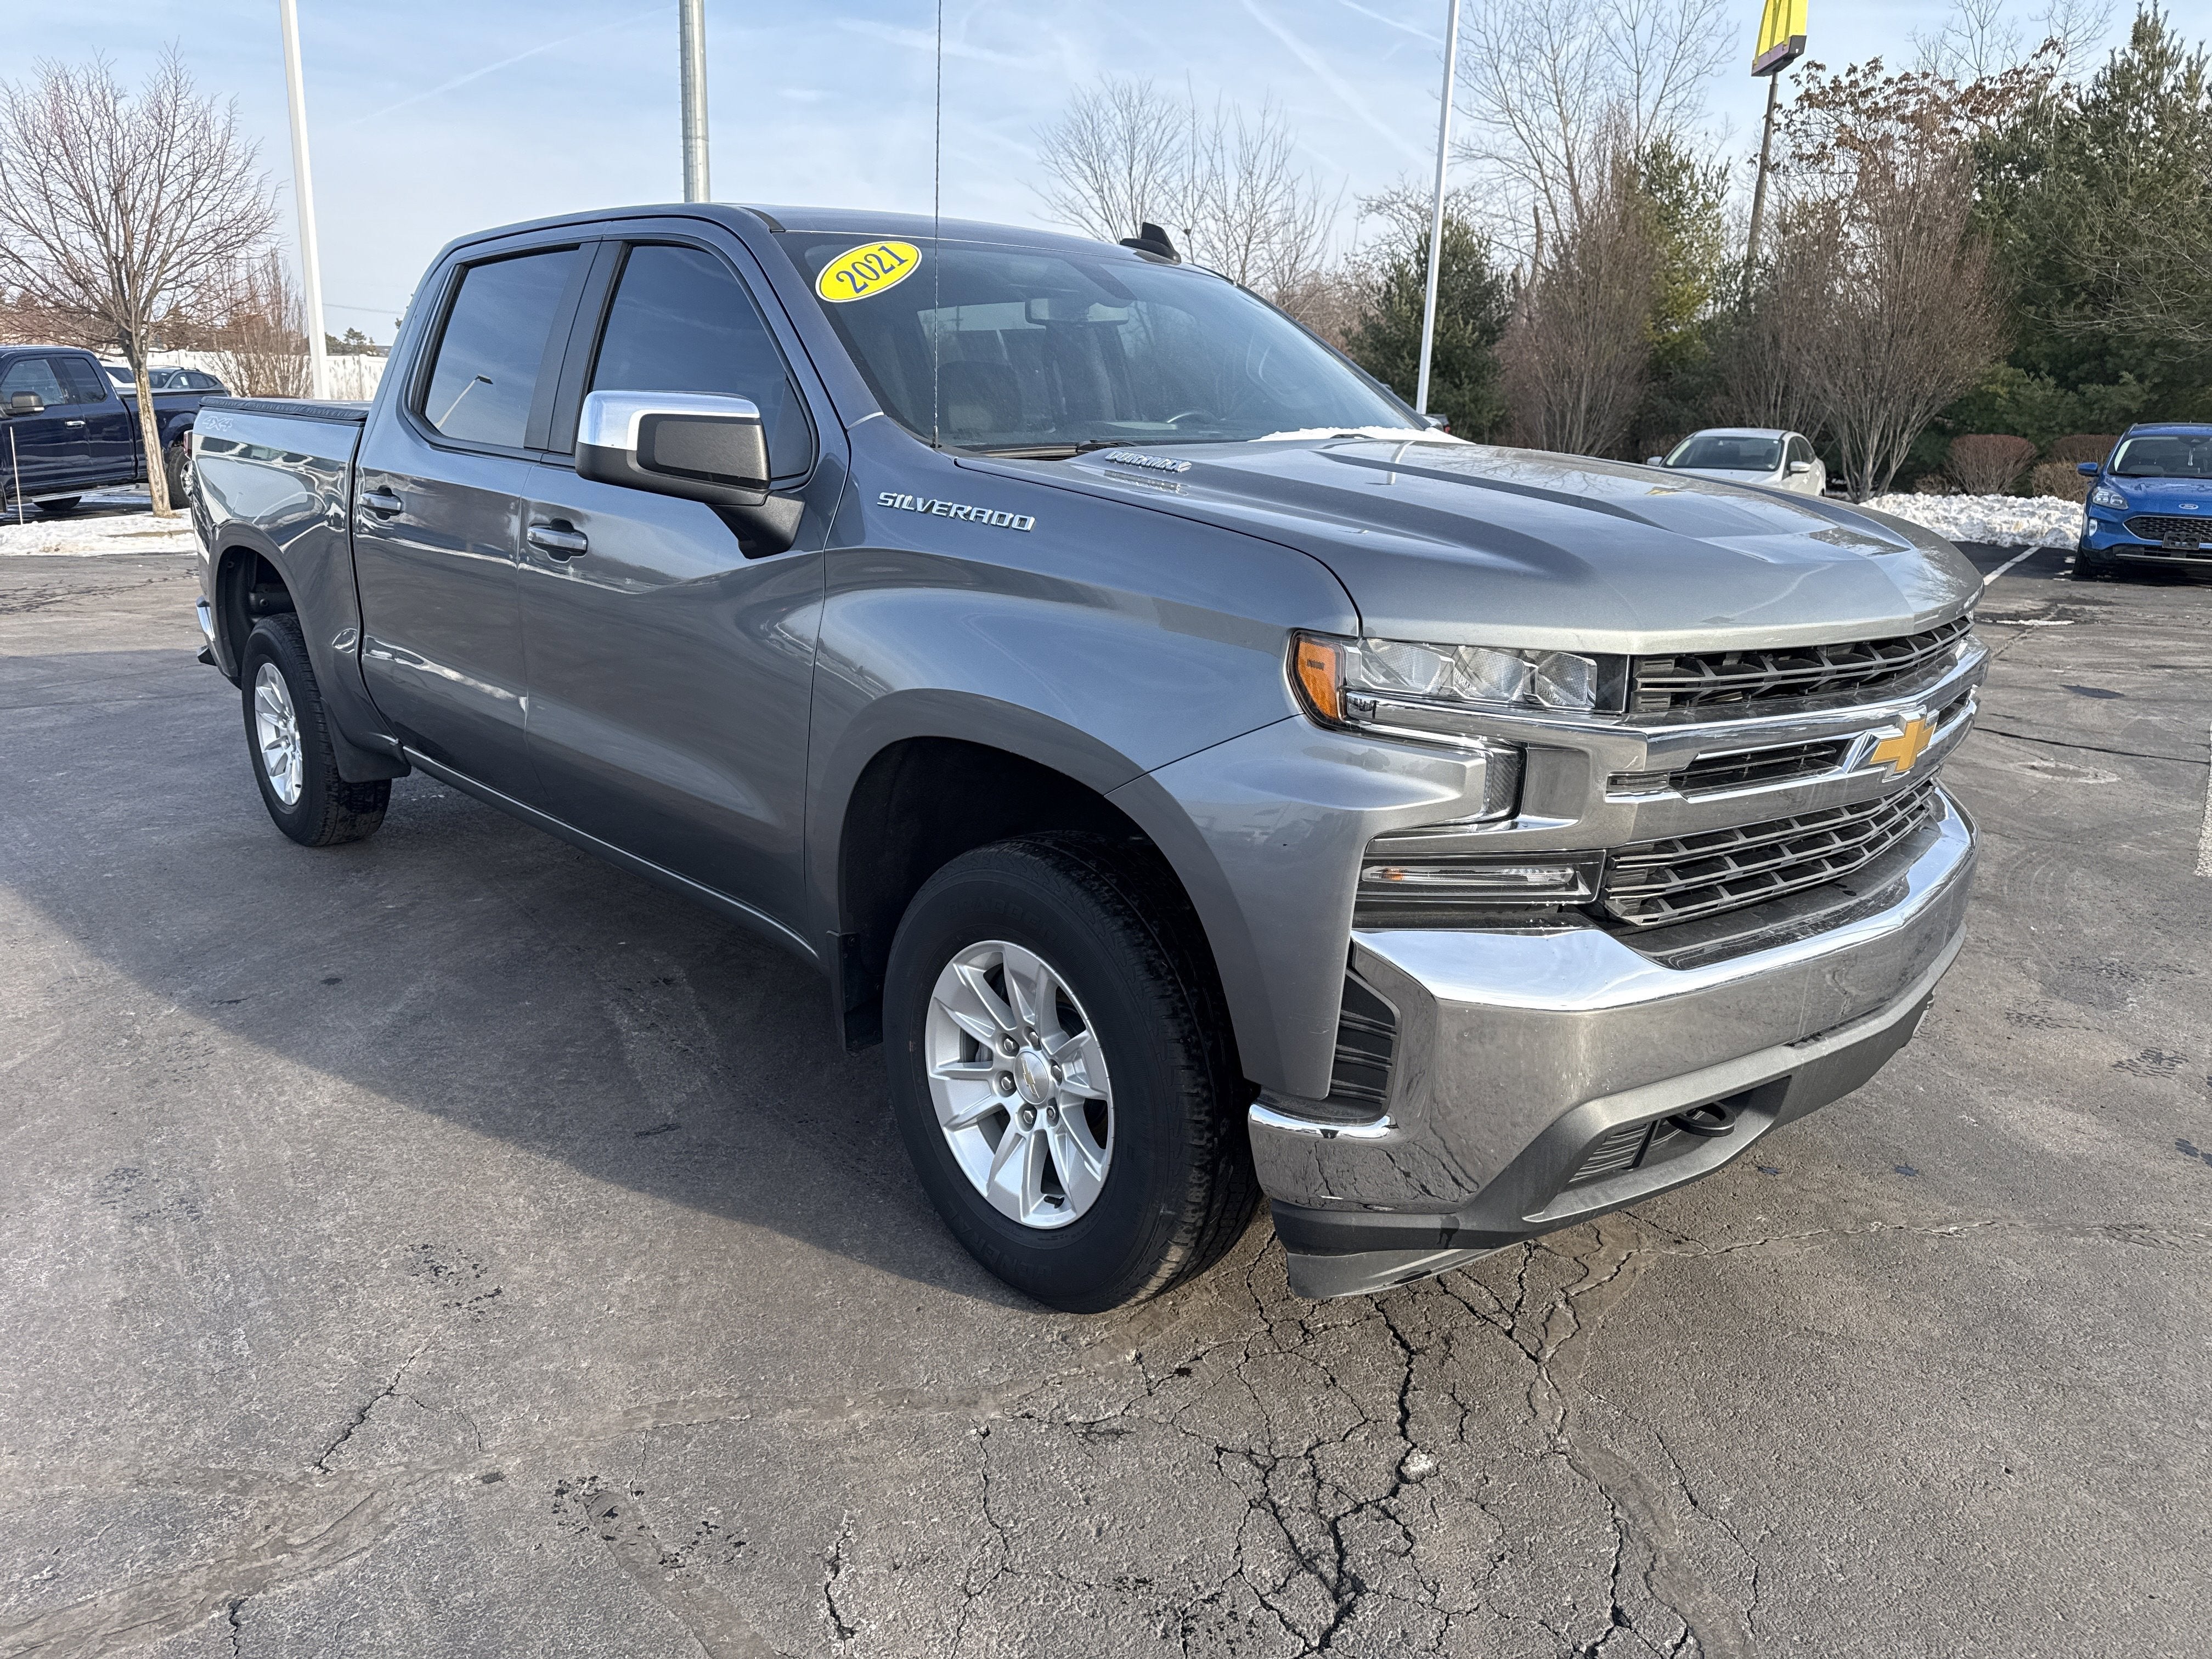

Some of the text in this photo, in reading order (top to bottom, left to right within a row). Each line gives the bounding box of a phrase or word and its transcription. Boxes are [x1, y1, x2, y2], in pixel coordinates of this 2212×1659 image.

[836, 246, 909, 294] 2021
[1104, 450, 1192, 472] DURAMAX
[877, 492, 1036, 532] SILVERADO
